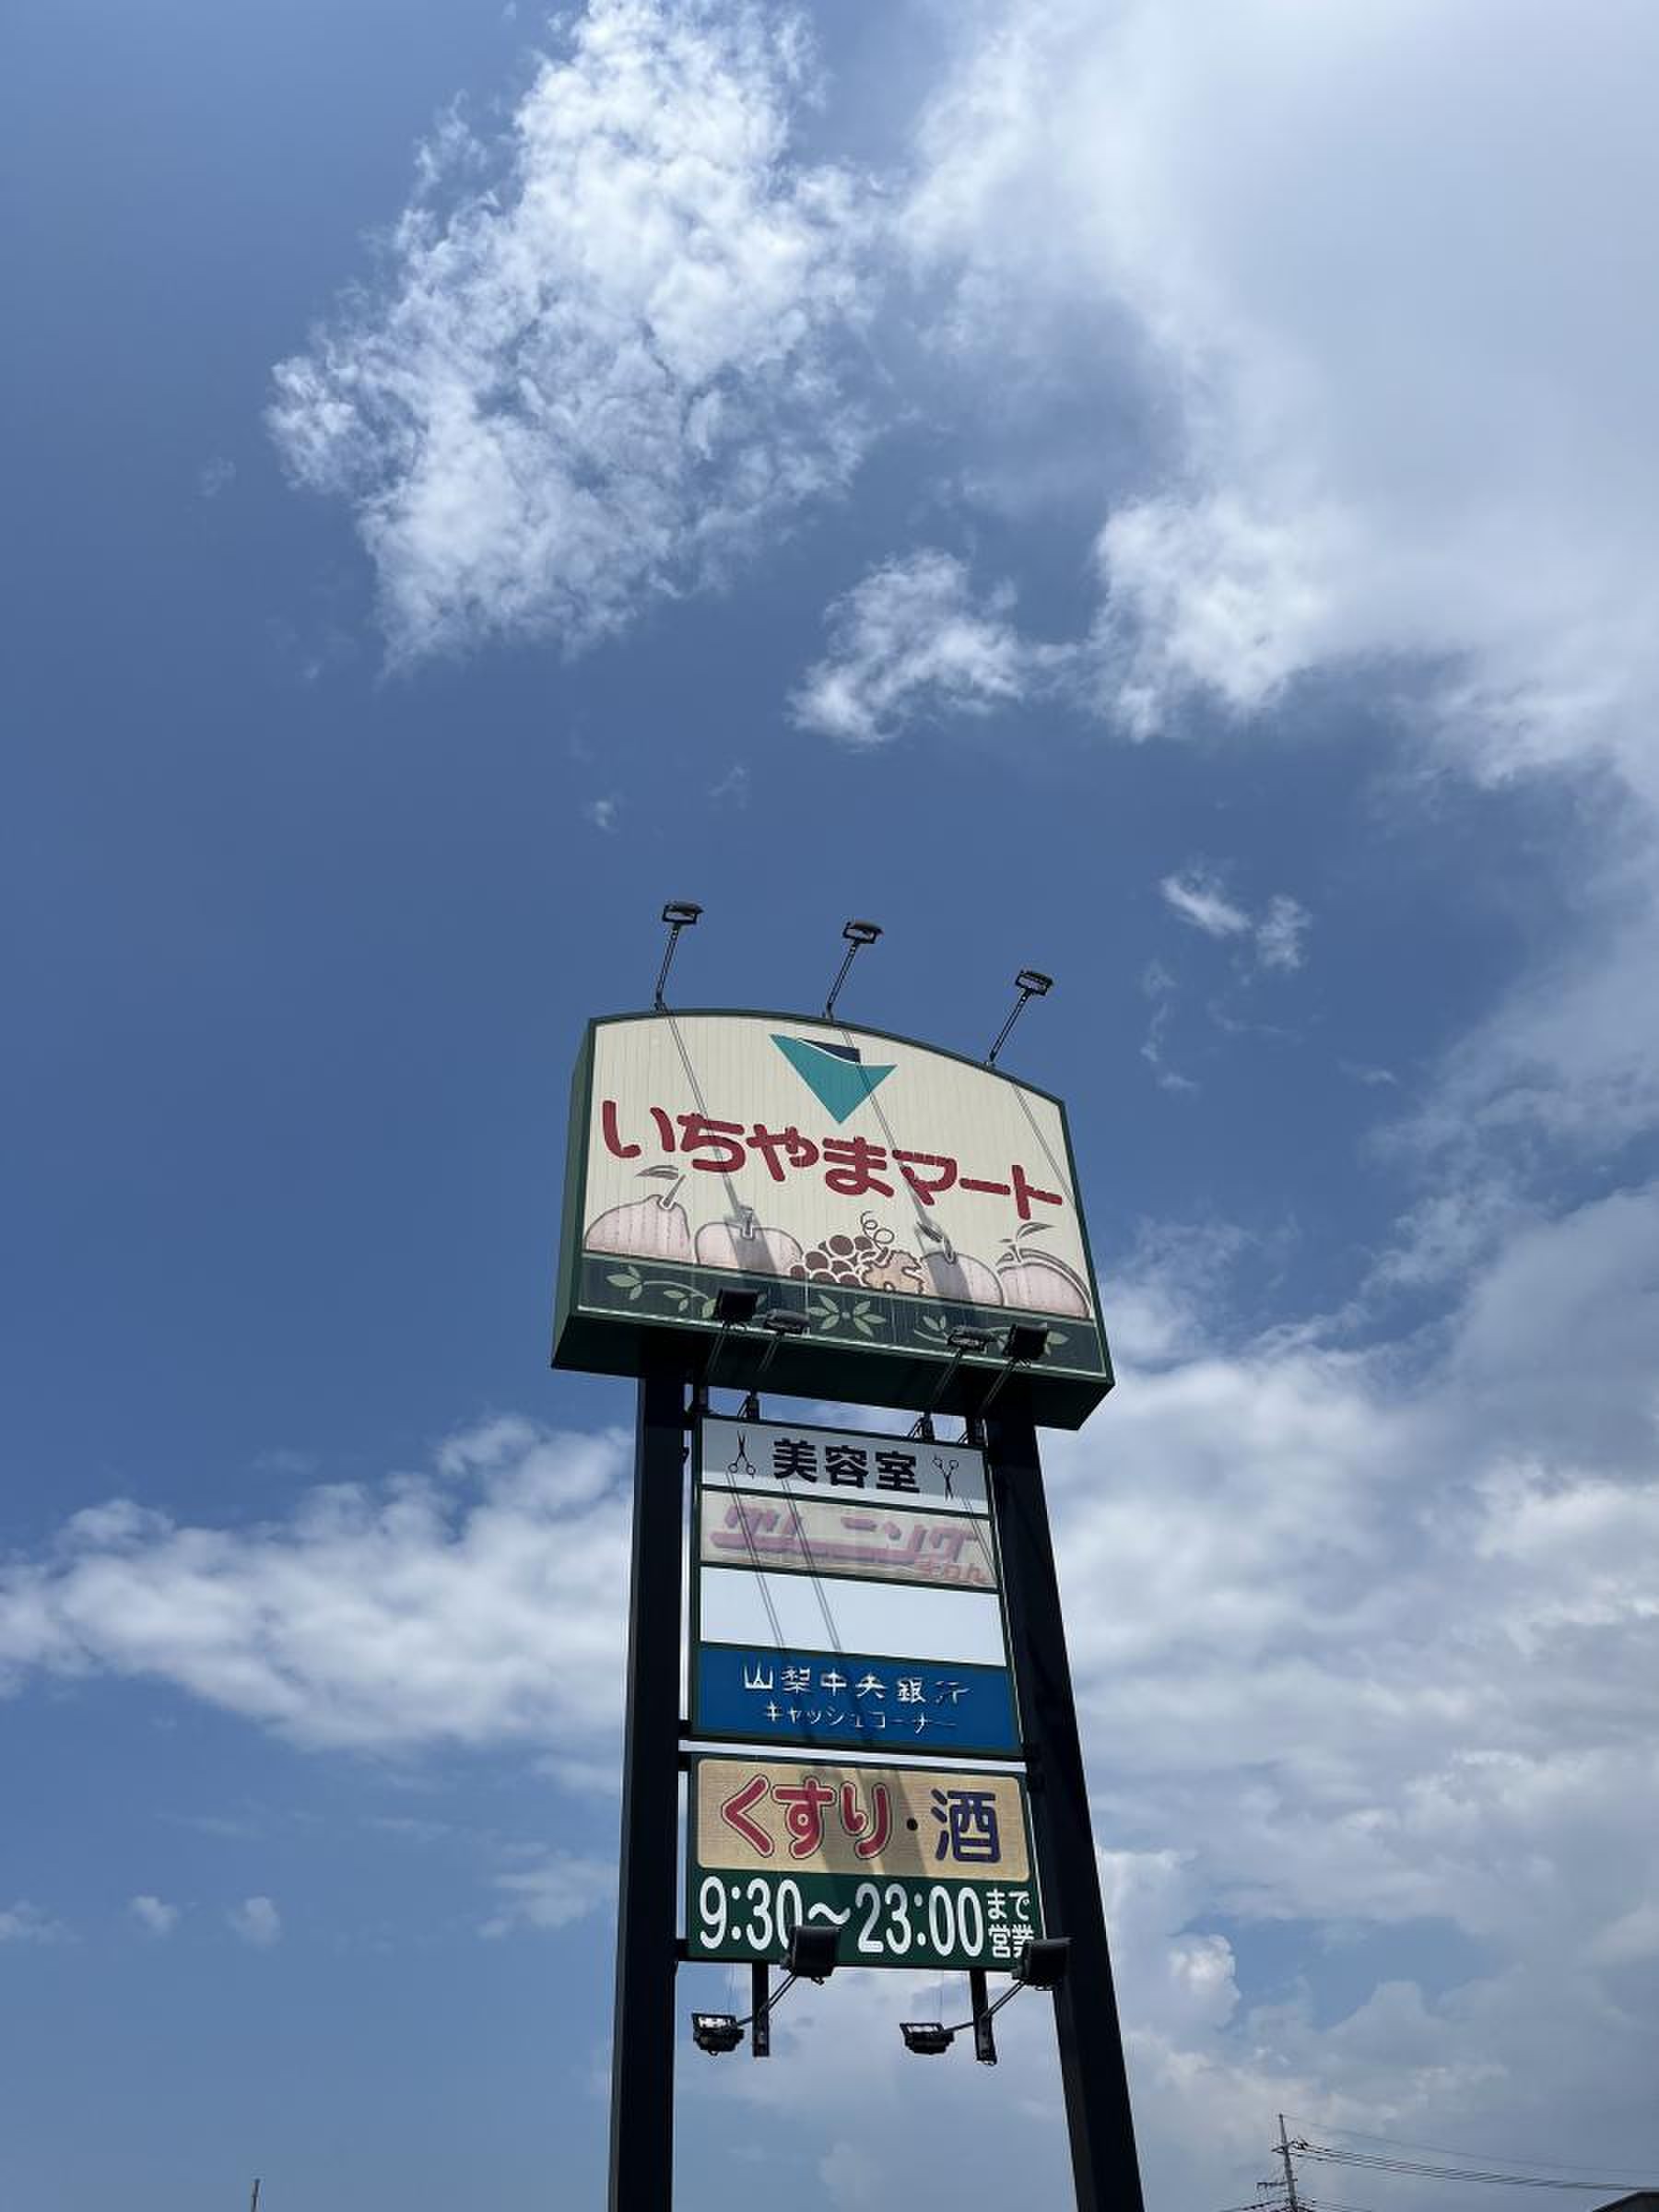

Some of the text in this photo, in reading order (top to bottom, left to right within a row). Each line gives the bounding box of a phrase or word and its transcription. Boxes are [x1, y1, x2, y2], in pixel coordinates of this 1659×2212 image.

[602, 1100, 1063, 1219] いちやまマート
[772, 1439, 920, 1494] 美容室
[743, 1660, 971, 1703] 山梨中央銀行
[985, 1888, 1030, 1921] まで
